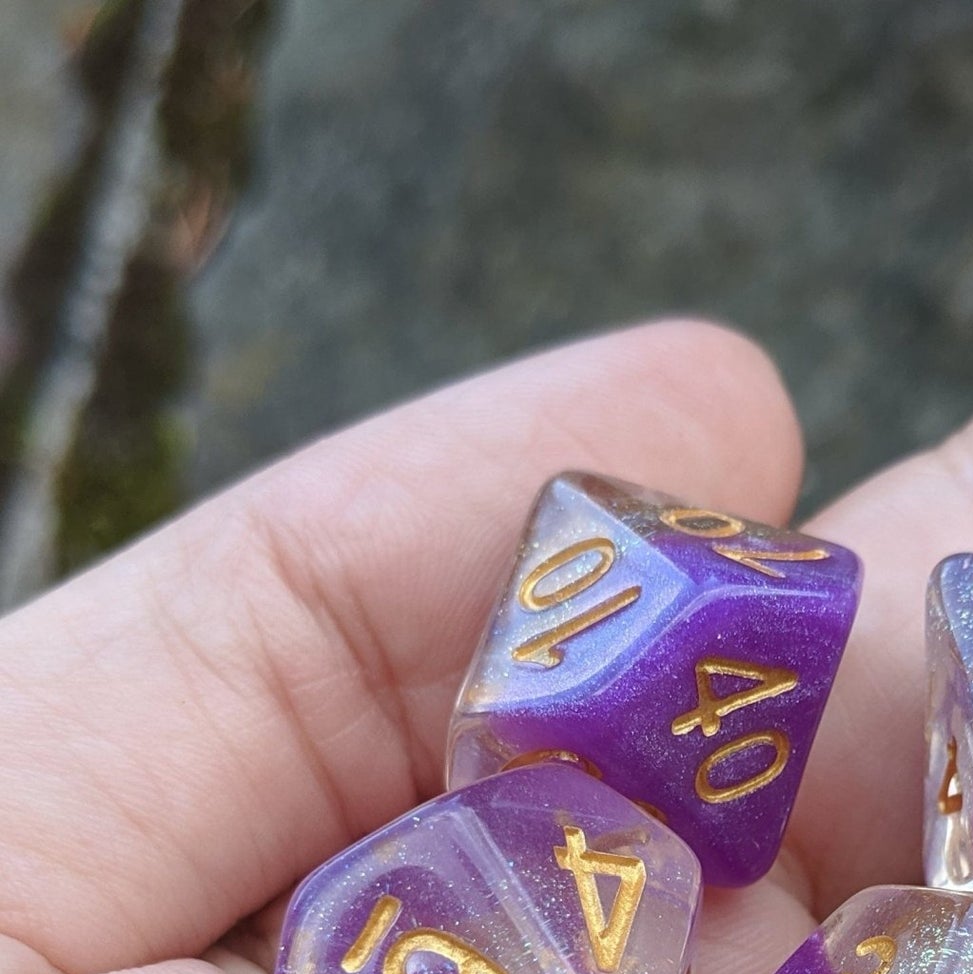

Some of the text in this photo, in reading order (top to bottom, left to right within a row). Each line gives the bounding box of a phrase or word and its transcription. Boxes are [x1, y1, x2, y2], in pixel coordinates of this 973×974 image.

[512, 537, 642, 669] 10
[671, 657, 798, 804] 40
[554, 825, 647, 973] 4
